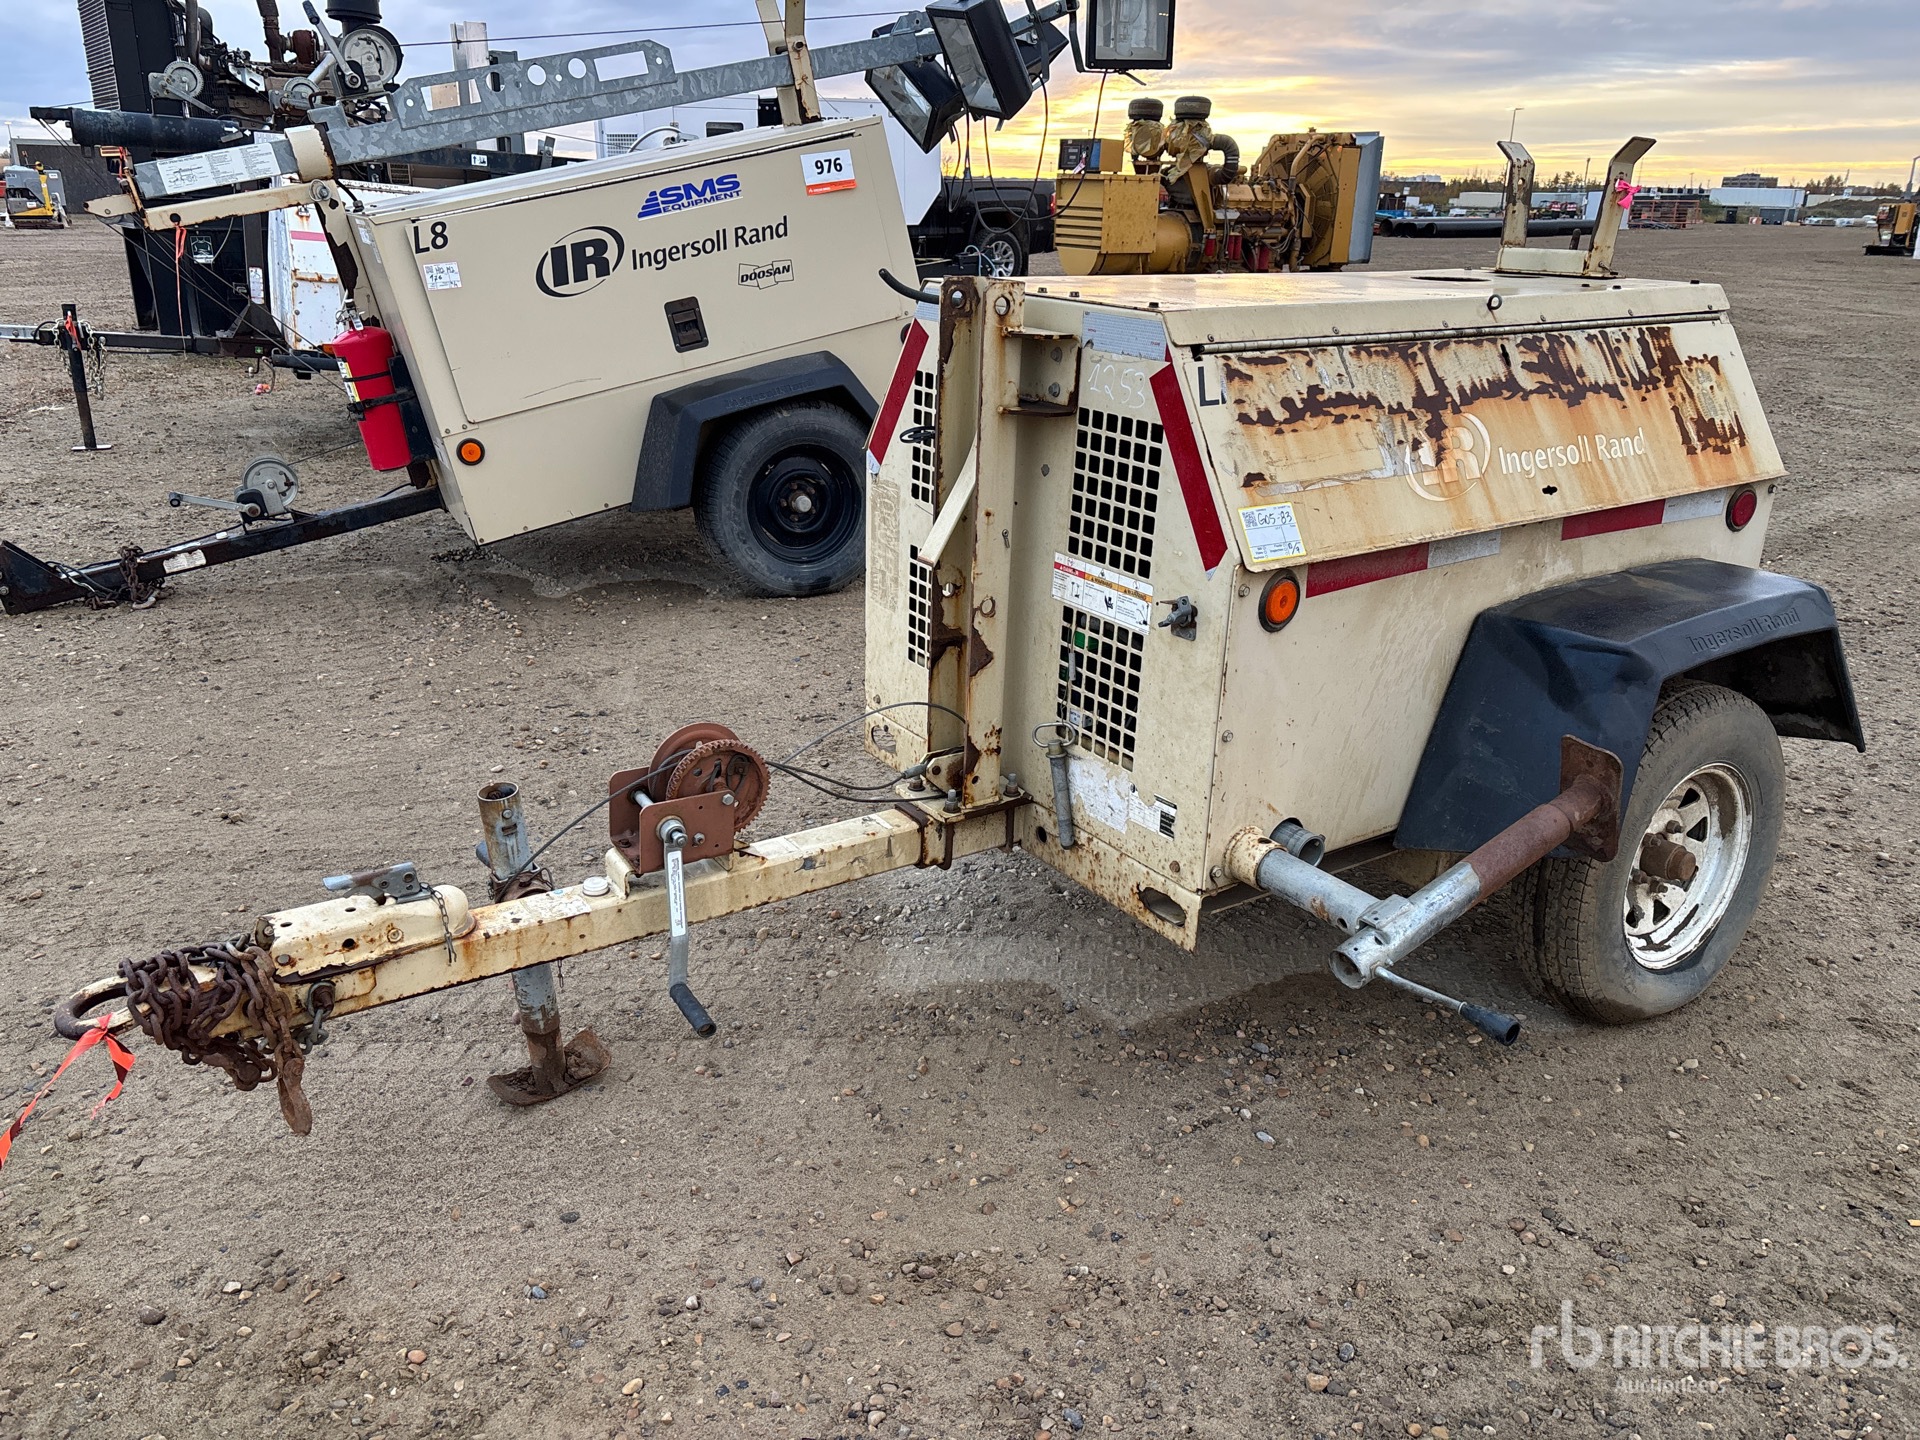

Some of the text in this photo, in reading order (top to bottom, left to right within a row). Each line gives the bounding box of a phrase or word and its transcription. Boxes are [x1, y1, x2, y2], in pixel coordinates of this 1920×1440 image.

[814, 157, 843, 175] 976
[658, 173, 741, 205] SMS
[662, 189, 742, 214] EQUIPMENT
[413, 221, 449, 254] L8
[631, 215, 789, 271] Ingersoll Rand
[550, 238, 611, 288] IR
[740, 264, 791, 284] DOOSAN
[1087, 363, 1146, 409] 1253
[1197, 366, 1227, 407] L
[1498, 427, 1647, 479] Ingersoll Rand
